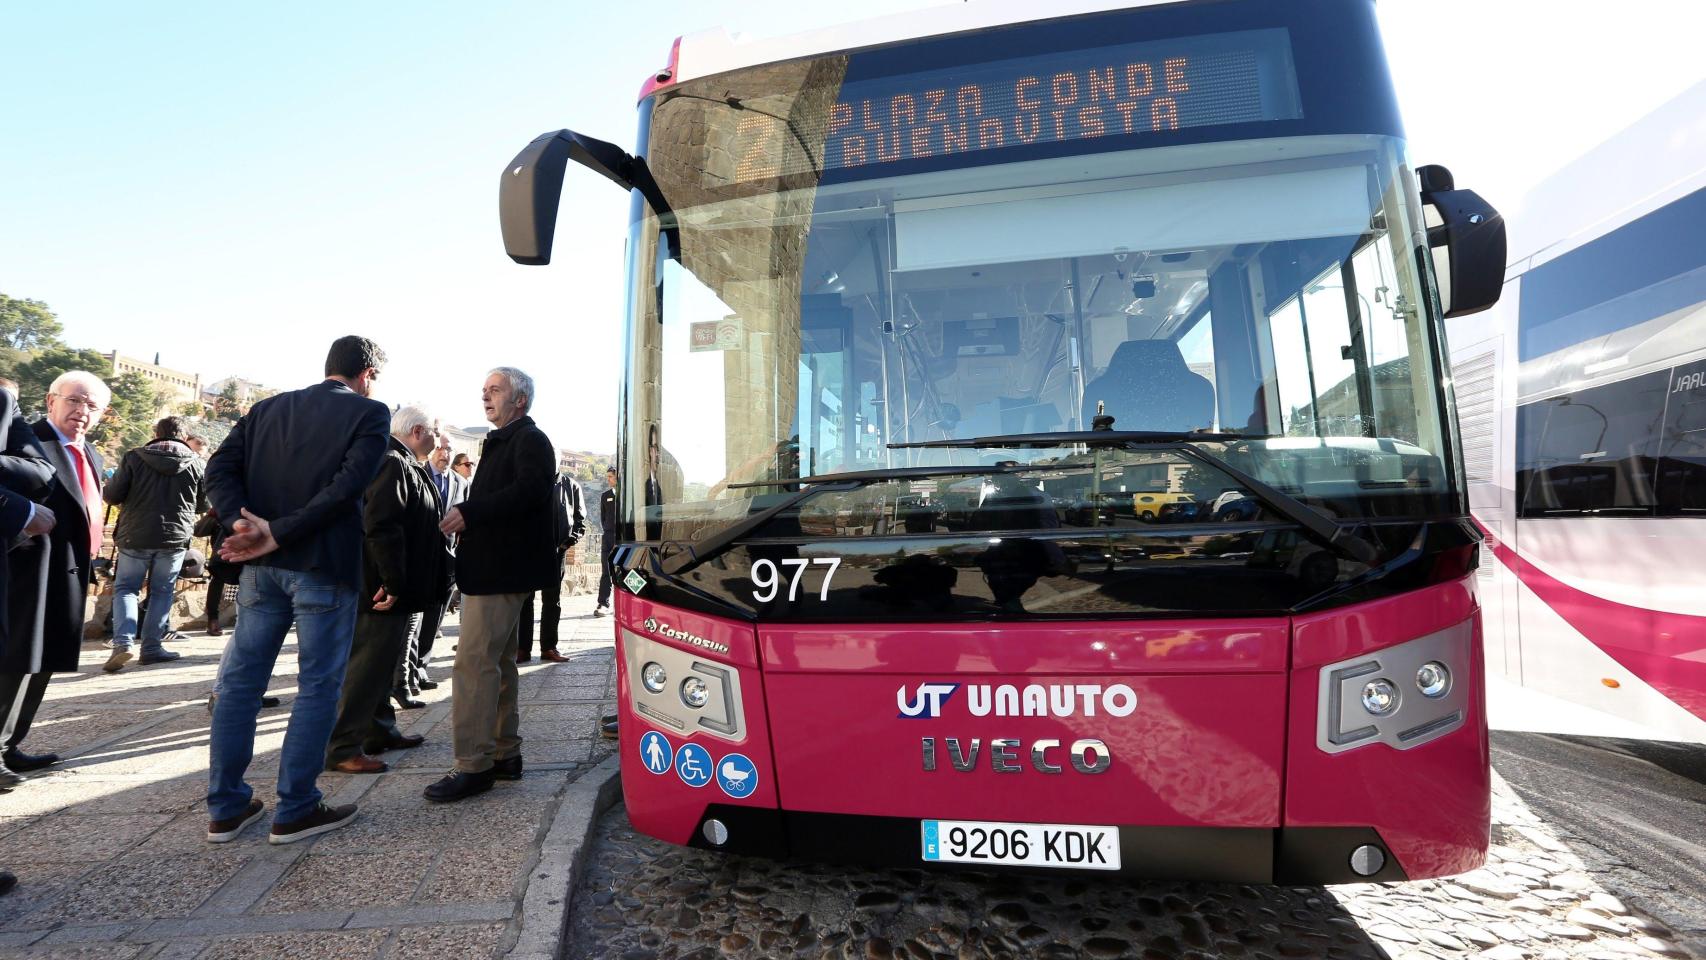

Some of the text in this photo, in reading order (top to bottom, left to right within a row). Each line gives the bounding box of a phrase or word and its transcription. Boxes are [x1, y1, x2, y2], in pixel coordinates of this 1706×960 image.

[829, 58, 1189, 134] PLAZA CONDE
[734, 116, 775, 182] 2
[843, 97, 1179, 167] BUENAVISTA
[627, 577, 641, 587] GNC
[750, 557, 842, 603] 977
[659, 623, 728, 653] Castrosua
[967, 683, 1138, 717] UNAUTO
[921, 736, 1112, 774] IVECO
[928, 826, 1107, 864] E 9206 KDK
